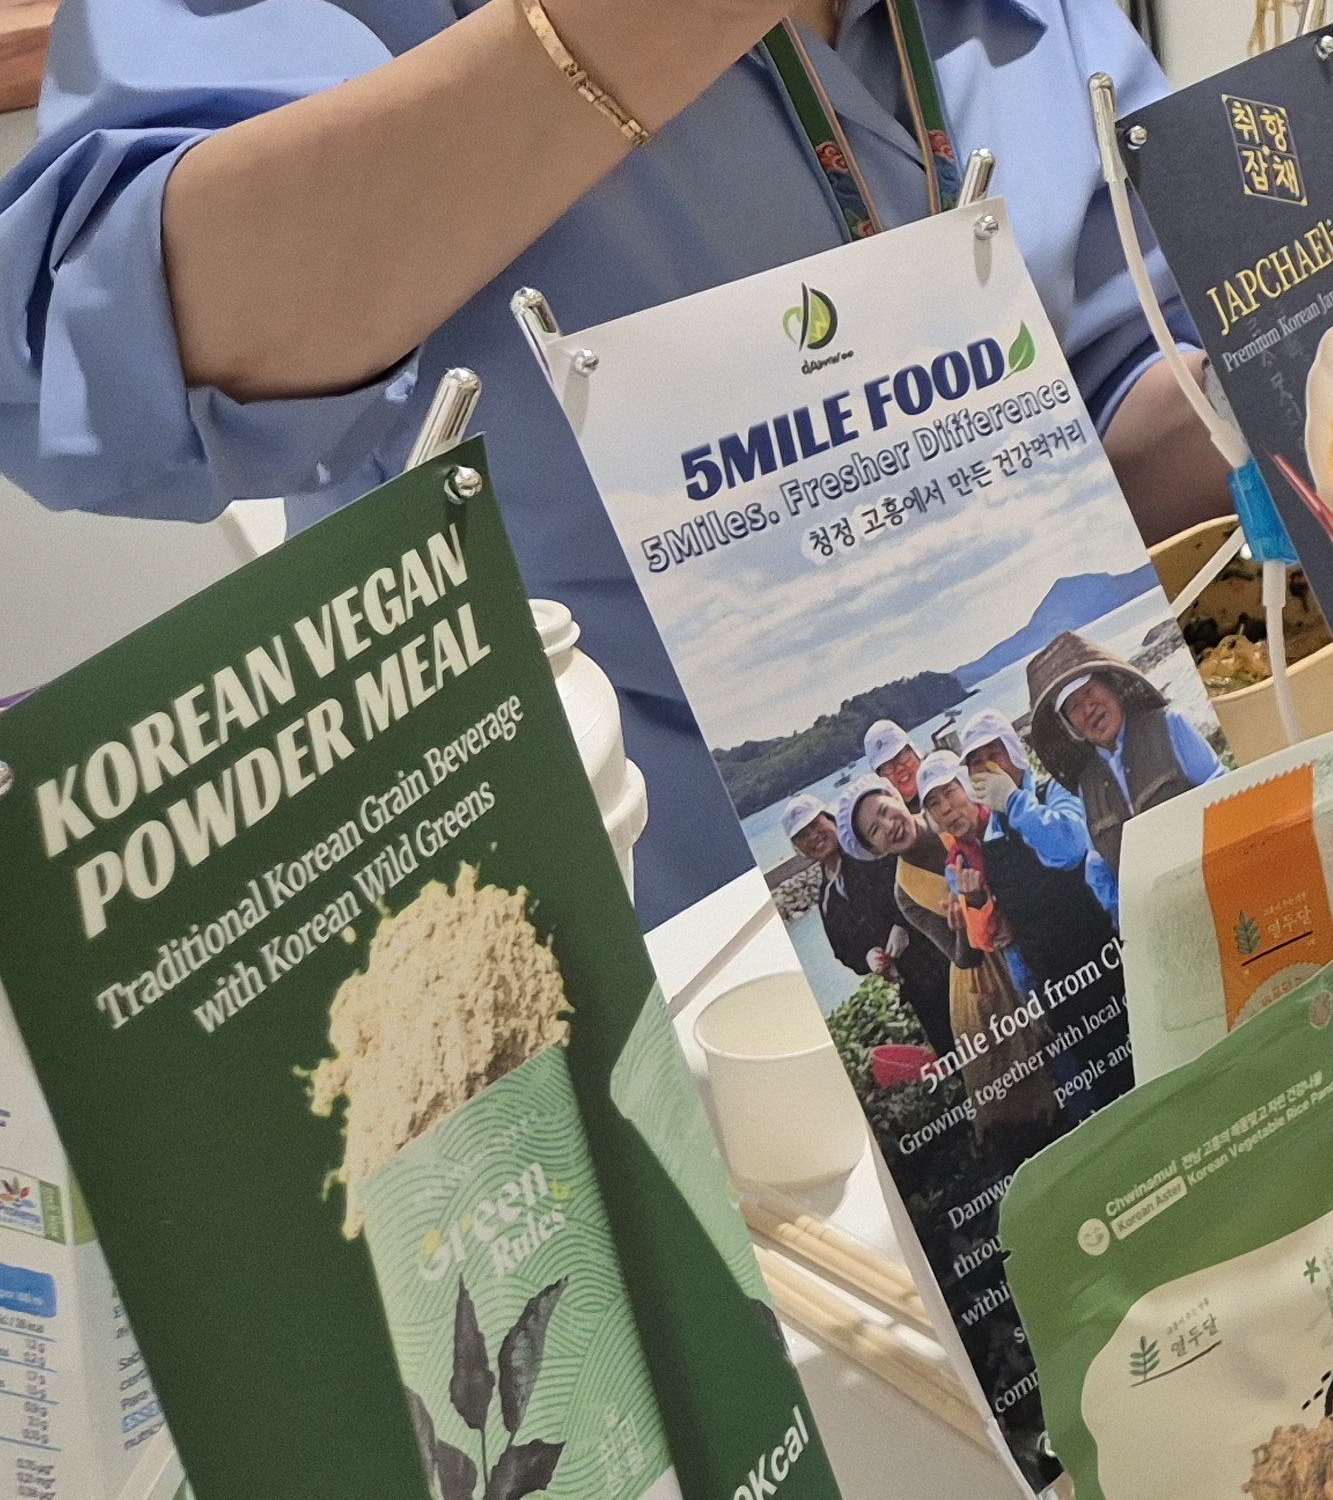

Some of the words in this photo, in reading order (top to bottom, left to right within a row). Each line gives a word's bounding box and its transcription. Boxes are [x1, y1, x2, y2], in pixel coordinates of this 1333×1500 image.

[1232, 100, 1288, 153] 취향
[1242, 148, 1300, 198] 잡채
[1221, 326, 1282, 373] Premium
[1278, 298, 1321, 341] Korean
[680, 390, 860, 501] 5MILE
[863, 337, 1006, 433] FOOD
[641, 501, 781, 574] 5Miles.
[780, 441, 912, 516] Fresher
[913, 377, 1070, 461] Difference
[809, 520, 857, 558] 청정
[862, 479, 947, 536] 고흥에서
[947, 459, 993, 496] 만든
[996, 420, 1088, 478] 건강먹거리
[35, 635, 298, 860] KOREAN
[293, 524, 469, 680] VEGAN
[75, 698, 356, 940] POWDER
[354, 602, 492, 742] MEAL
[97, 881, 270, 1030] Traditional
[263, 820, 364, 910] Korean
[360, 769, 430, 834] Grain
[423, 694, 525, 787] Beverage
[192, 961, 268, 1034] with
[260, 891, 362, 979] Korean
[353, 833, 419, 904] Wild
[415, 779, 497, 858] Greens
[920, 1031, 990, 1094] 5mile
[989, 989, 1045, 1045] food
[1044, 959, 1102, 1010] from
[899, 1097, 978, 1155] Growing
[974, 1050, 1046, 1106] together
[1045, 1023, 1084, 1058] with
[1083, 996, 1122, 1035] local
[1053, 1054, 1108, 1109] people
[1187, 1152, 1230, 1187] Korean
[1228, 1117, 1286, 1157] Vegetable
[1286, 1099, 1310, 1123] Rice
[948, 1173, 1014, 1230] Damwo
[1105, 1159, 1178, 1217] Chwinamul
[1116, 1196, 1154, 1233] Korean
[1153, 1181, 1183, 1213] Aster
[953, 1234, 1004, 1279] throu
[961, 1281, 1012, 1327] withi
